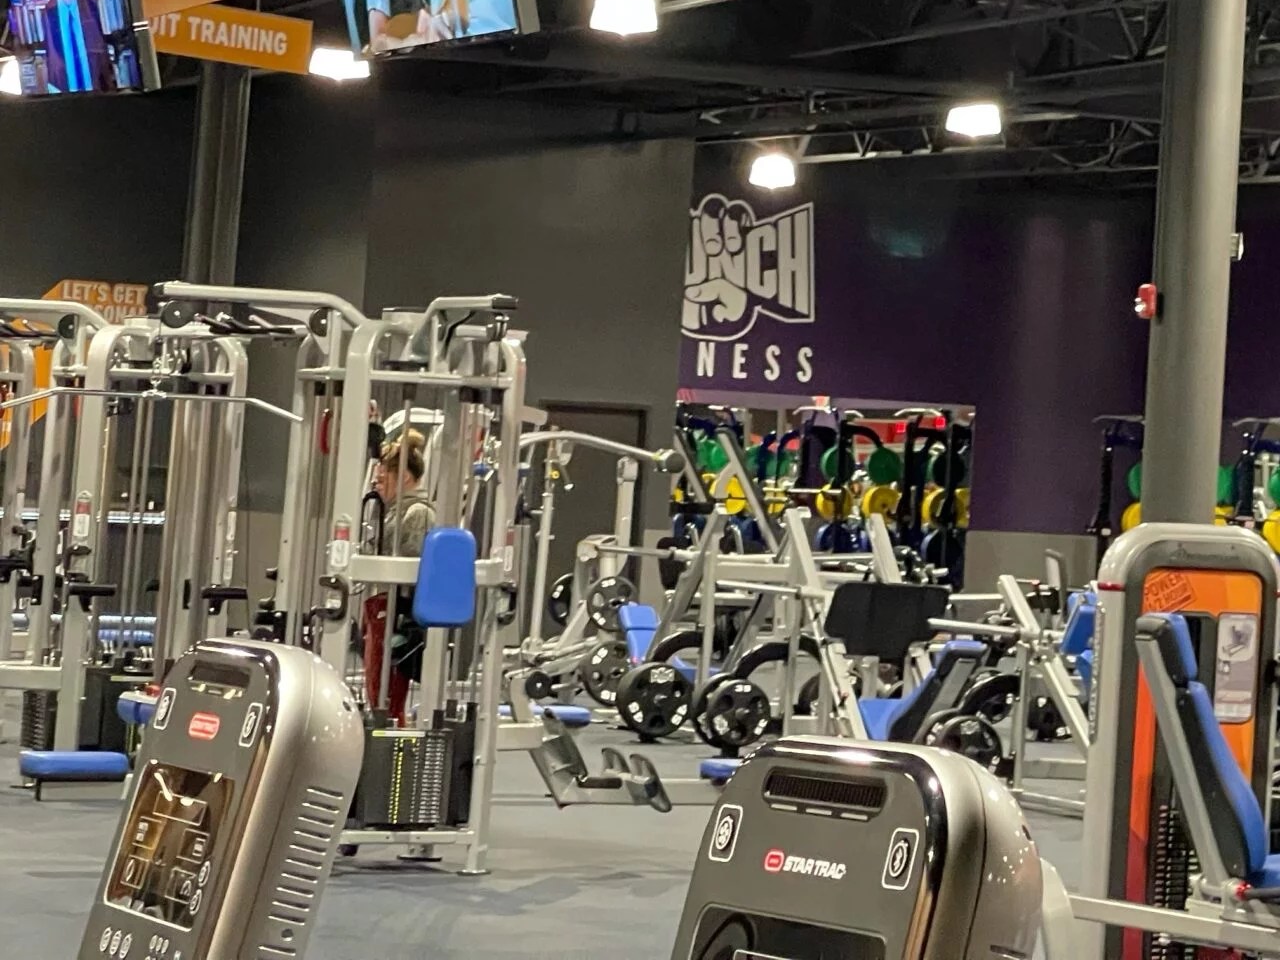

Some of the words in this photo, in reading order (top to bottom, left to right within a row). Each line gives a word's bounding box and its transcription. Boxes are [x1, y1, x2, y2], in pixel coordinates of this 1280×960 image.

[187, 16, 288, 56] TRAINING
[63, 280, 111, 302] LET'S
[113, 284, 148, 305] GET
[697, 341, 813, 383] NESS
